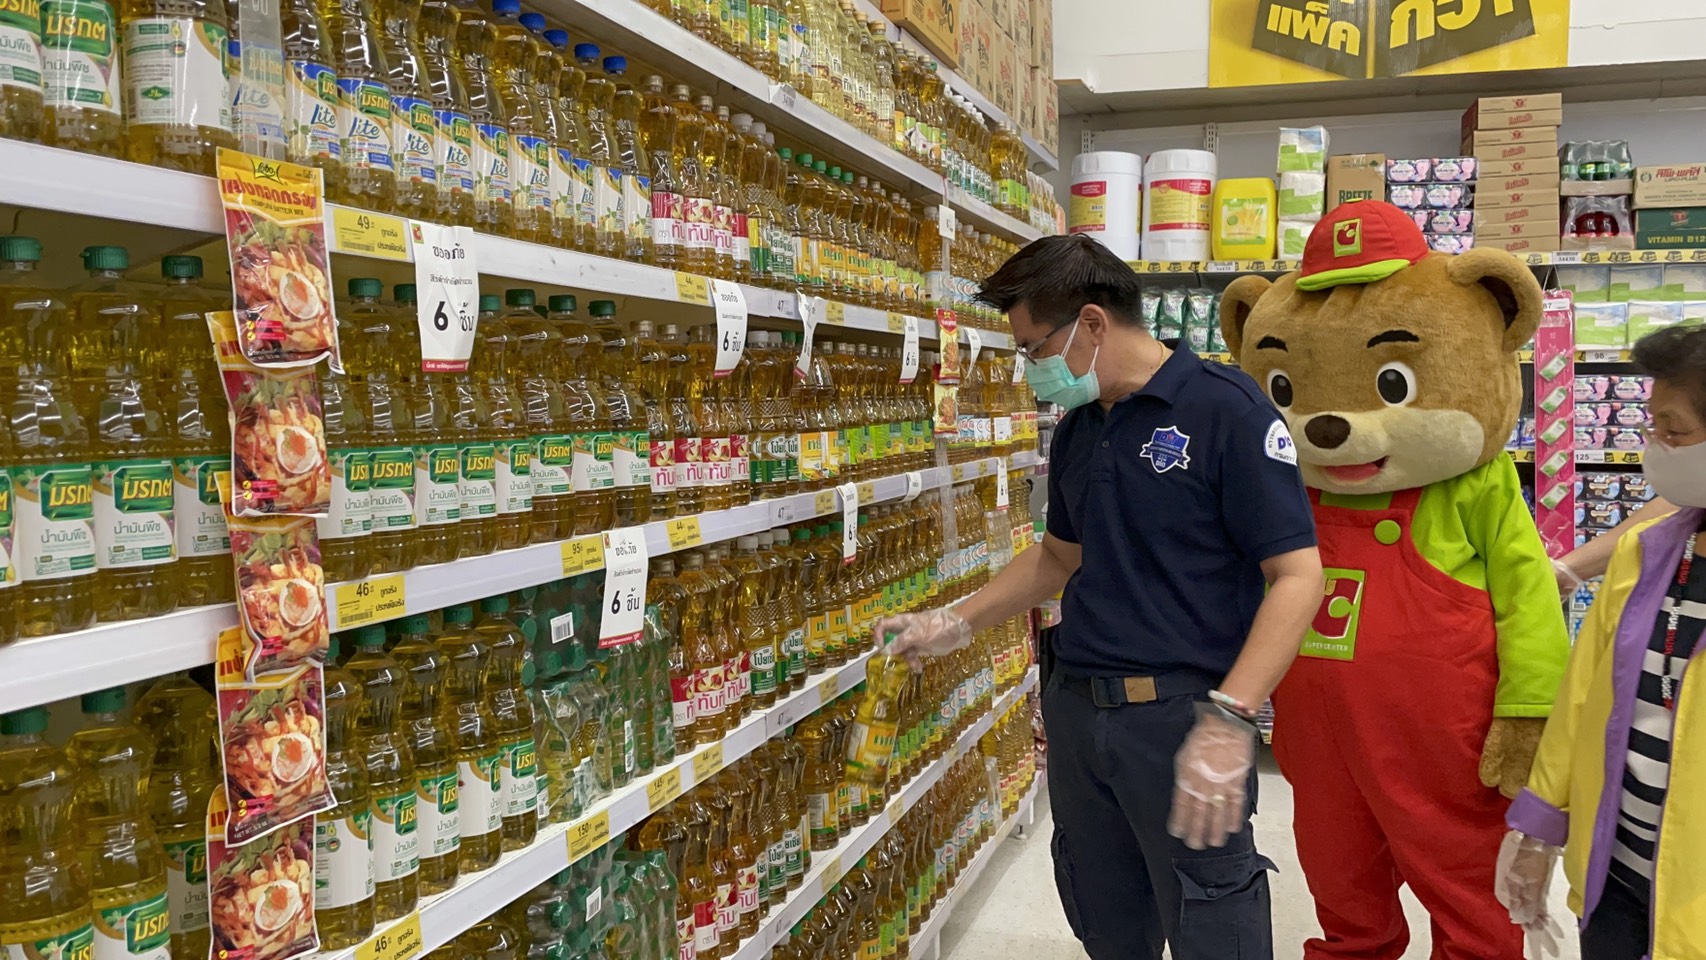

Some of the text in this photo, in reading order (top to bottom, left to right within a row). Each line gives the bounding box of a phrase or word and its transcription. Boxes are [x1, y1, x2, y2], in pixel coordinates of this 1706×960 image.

[46, 15, 106, 41] มรกต
[1267, 1, 1360, 56] แพ็ค
[311, 104, 336, 128] Lite
[350, 117, 380, 139] Lite
[405, 133, 430, 155] Lite
[446, 146, 468, 166] Lite
[1647, 235, 1706, 245] VITAMIN B12
[433, 301, 474, 332] 6 ชิ้น
[723, 331, 729, 352] 6
[905, 352, 910, 366] 6
[544, 446, 570, 458] มรกต
[373, 461, 413, 479] มรกต
[122, 479, 172, 499] มรกต
[40, 528, 87, 544] น้ำมันพืช
[113, 519, 161, 536] น้ำมันพืช
[848, 524, 853, 541] 6
[380, 585, 397, 598] ถูกจริง
[611, 587, 640, 614] 6 ชิ้น
[134, 909, 170, 941] มรก
